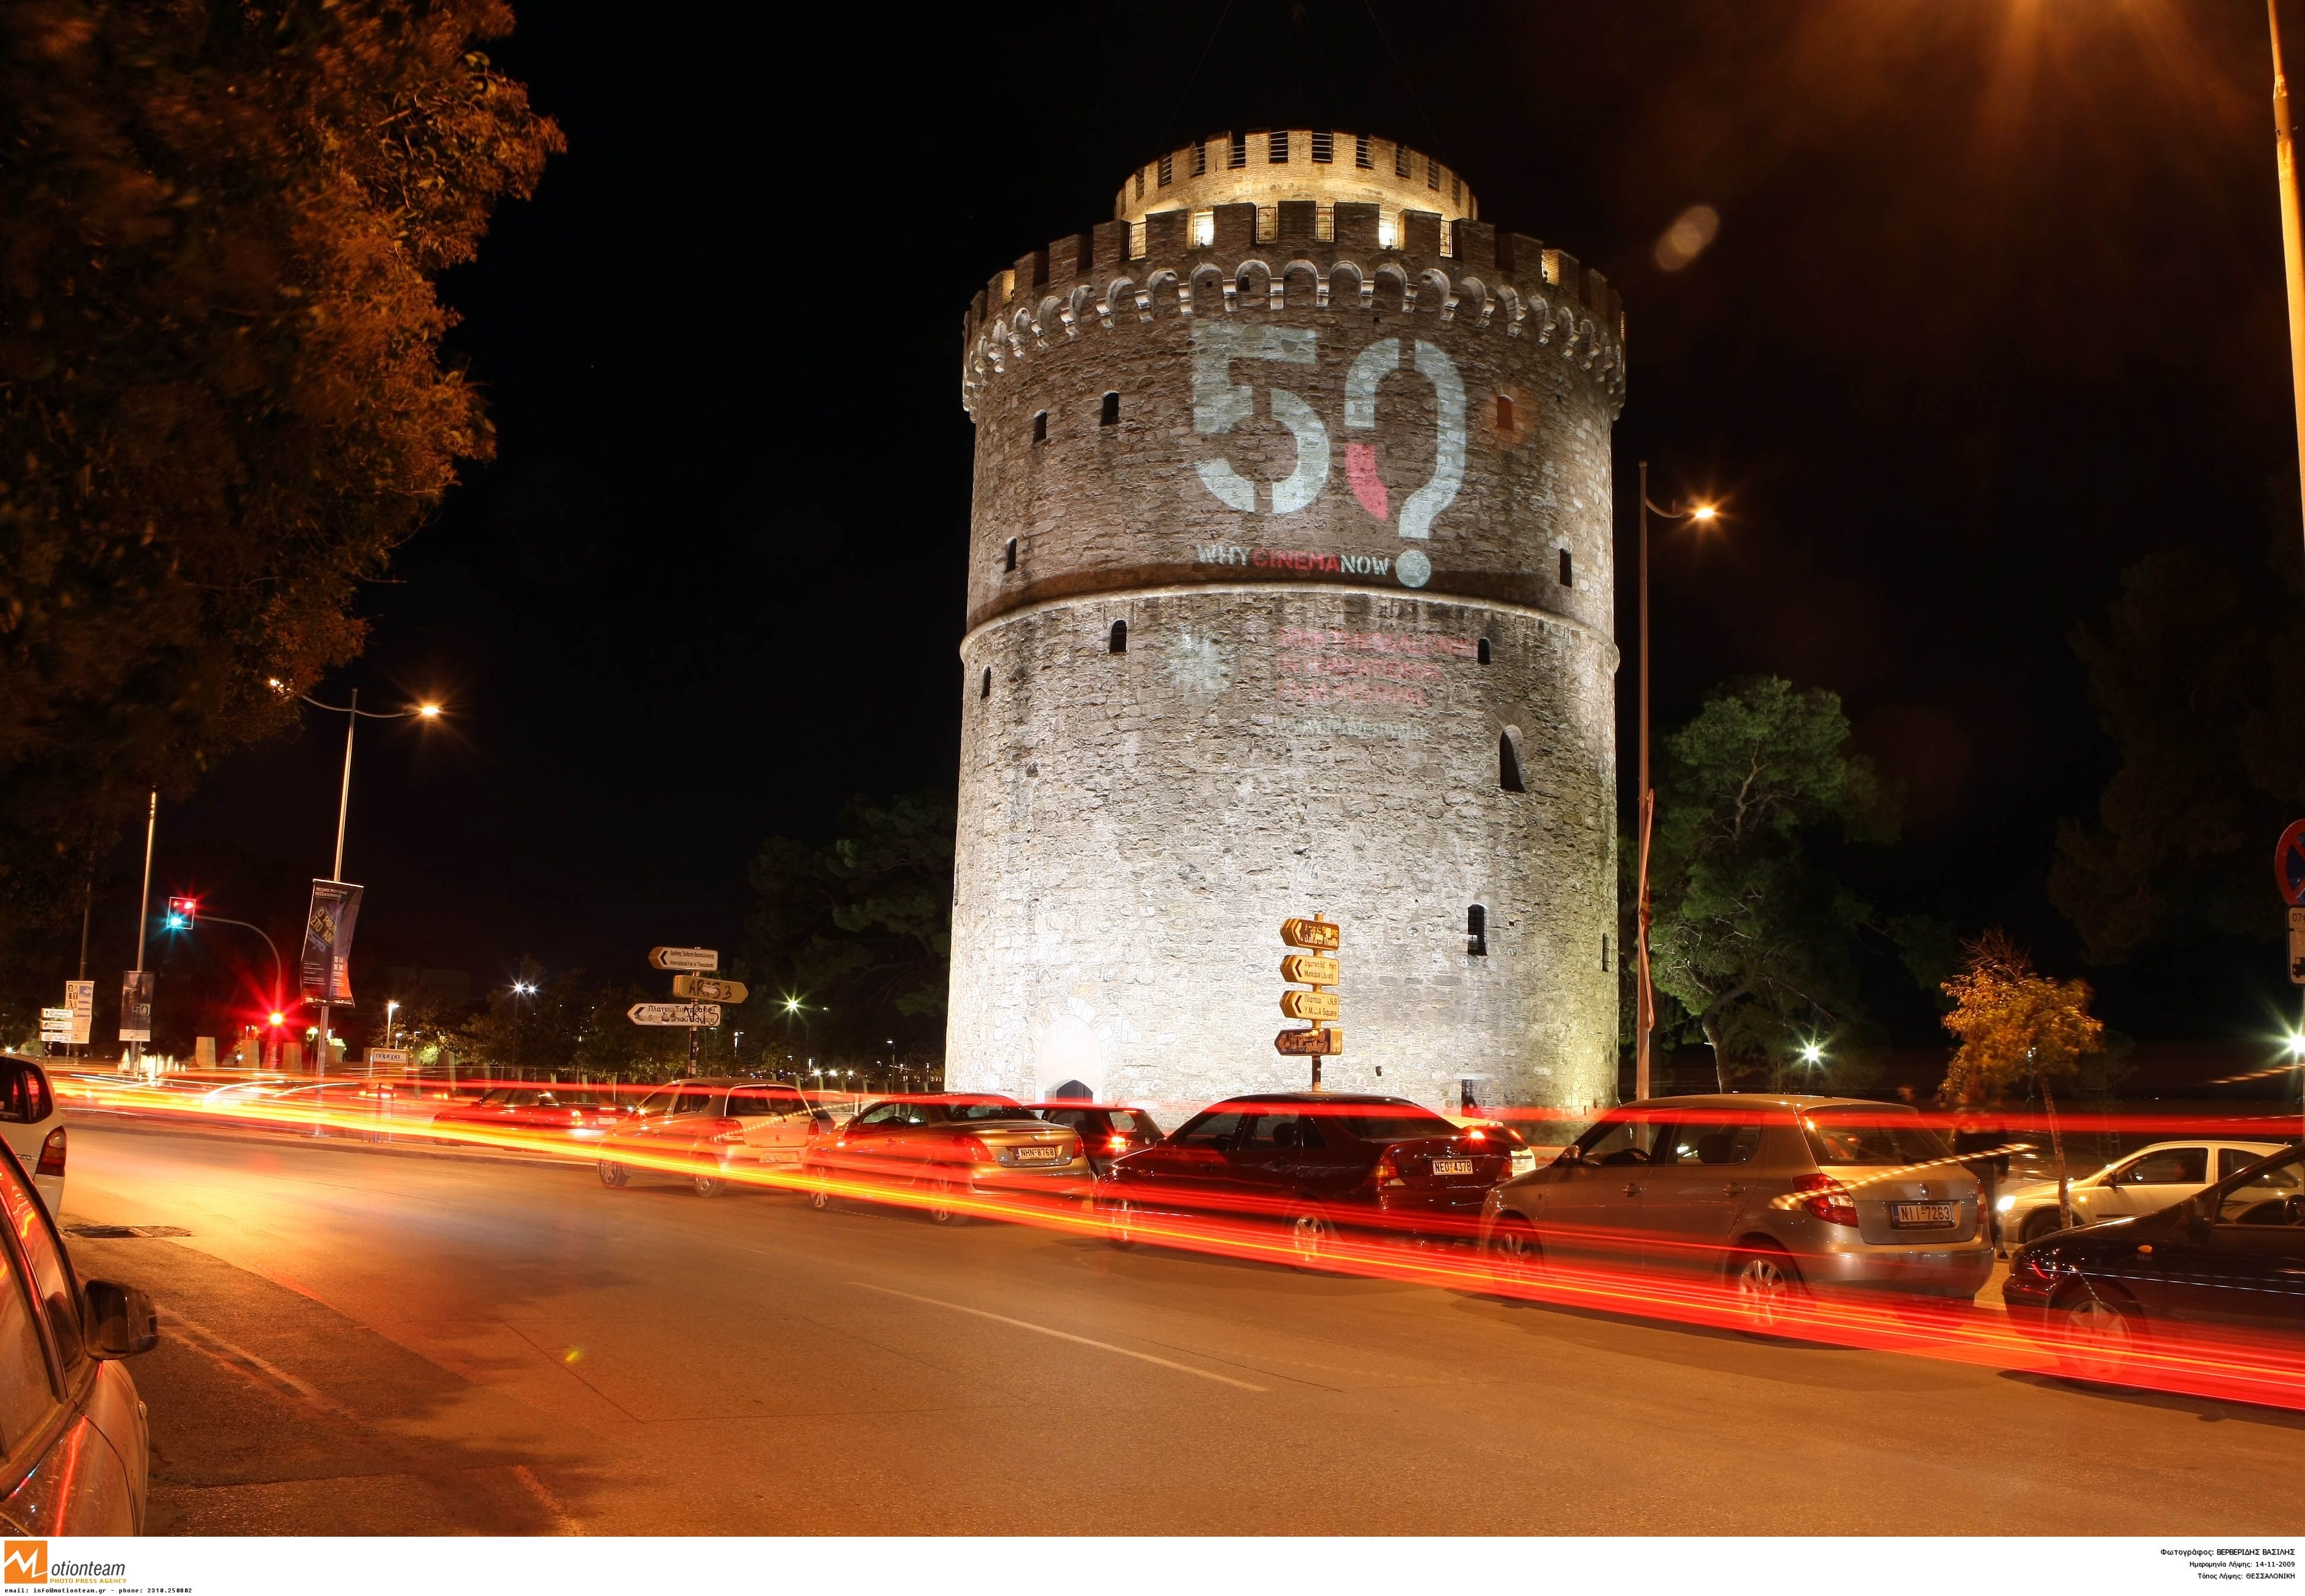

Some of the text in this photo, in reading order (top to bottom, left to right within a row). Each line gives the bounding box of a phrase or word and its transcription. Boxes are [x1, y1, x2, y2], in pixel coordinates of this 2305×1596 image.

[1196, 544, 1390, 575] WHY CINEMA NOW
